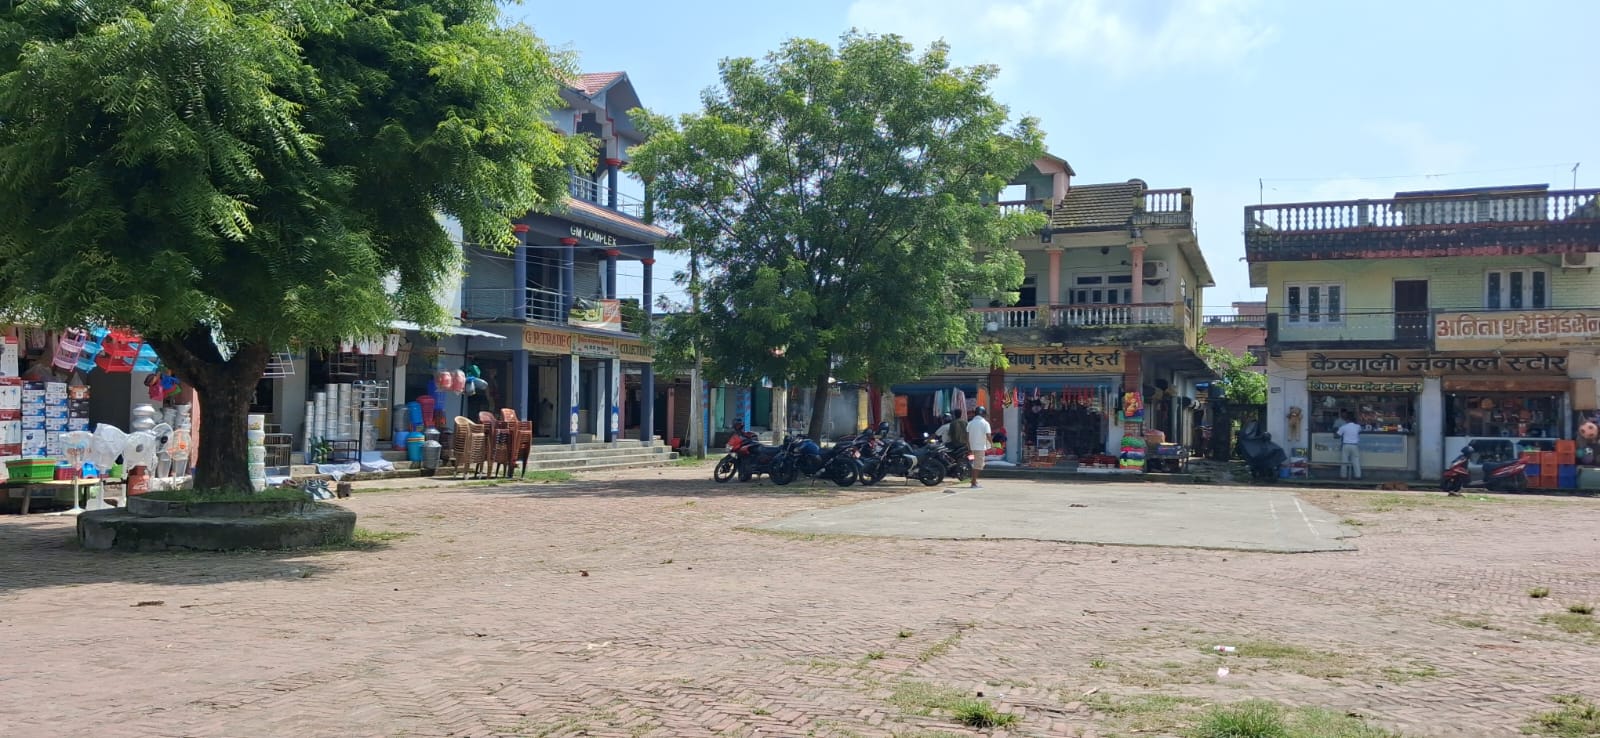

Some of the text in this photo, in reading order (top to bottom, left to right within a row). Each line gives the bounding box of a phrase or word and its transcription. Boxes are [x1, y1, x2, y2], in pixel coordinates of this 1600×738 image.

[570, 224, 617, 248] GM COMPLEX
[1309, 352, 1401, 372] कैलाली
[1502, 351, 1569, 372] स्टोर
